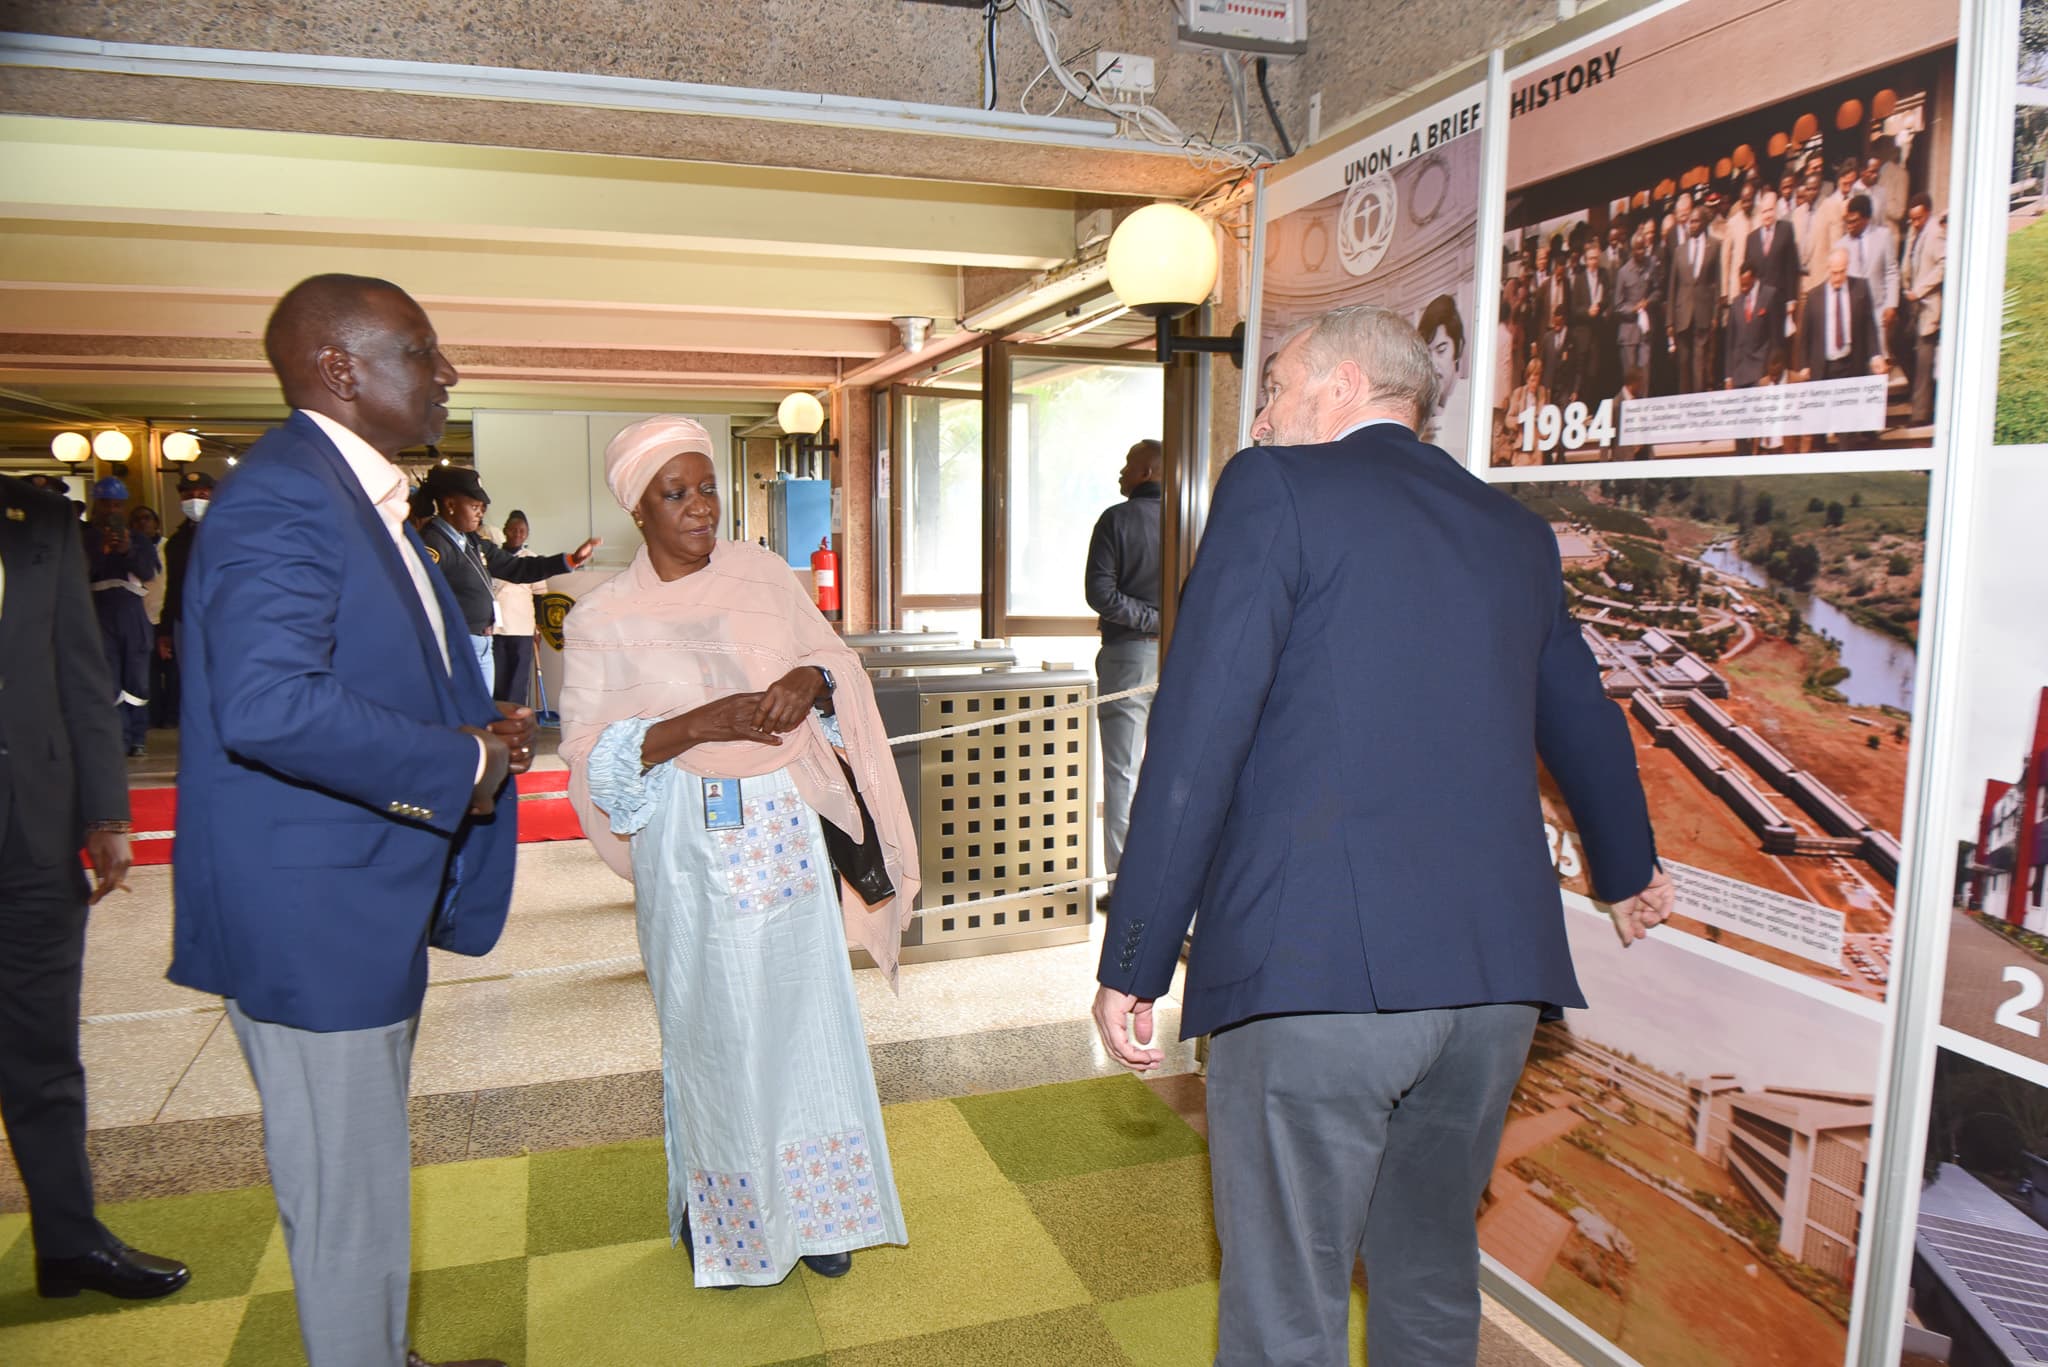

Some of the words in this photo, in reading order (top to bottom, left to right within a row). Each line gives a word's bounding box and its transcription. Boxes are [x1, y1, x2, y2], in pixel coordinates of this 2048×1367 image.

[1344, 144, 1392, 186] UNON
[1409, 131, 1420, 158] A
[1427, 102, 1481, 150] BRIEF
[1510, 45, 1622, 120] HISTORY
[1517, 398, 1616, 452] 1984
